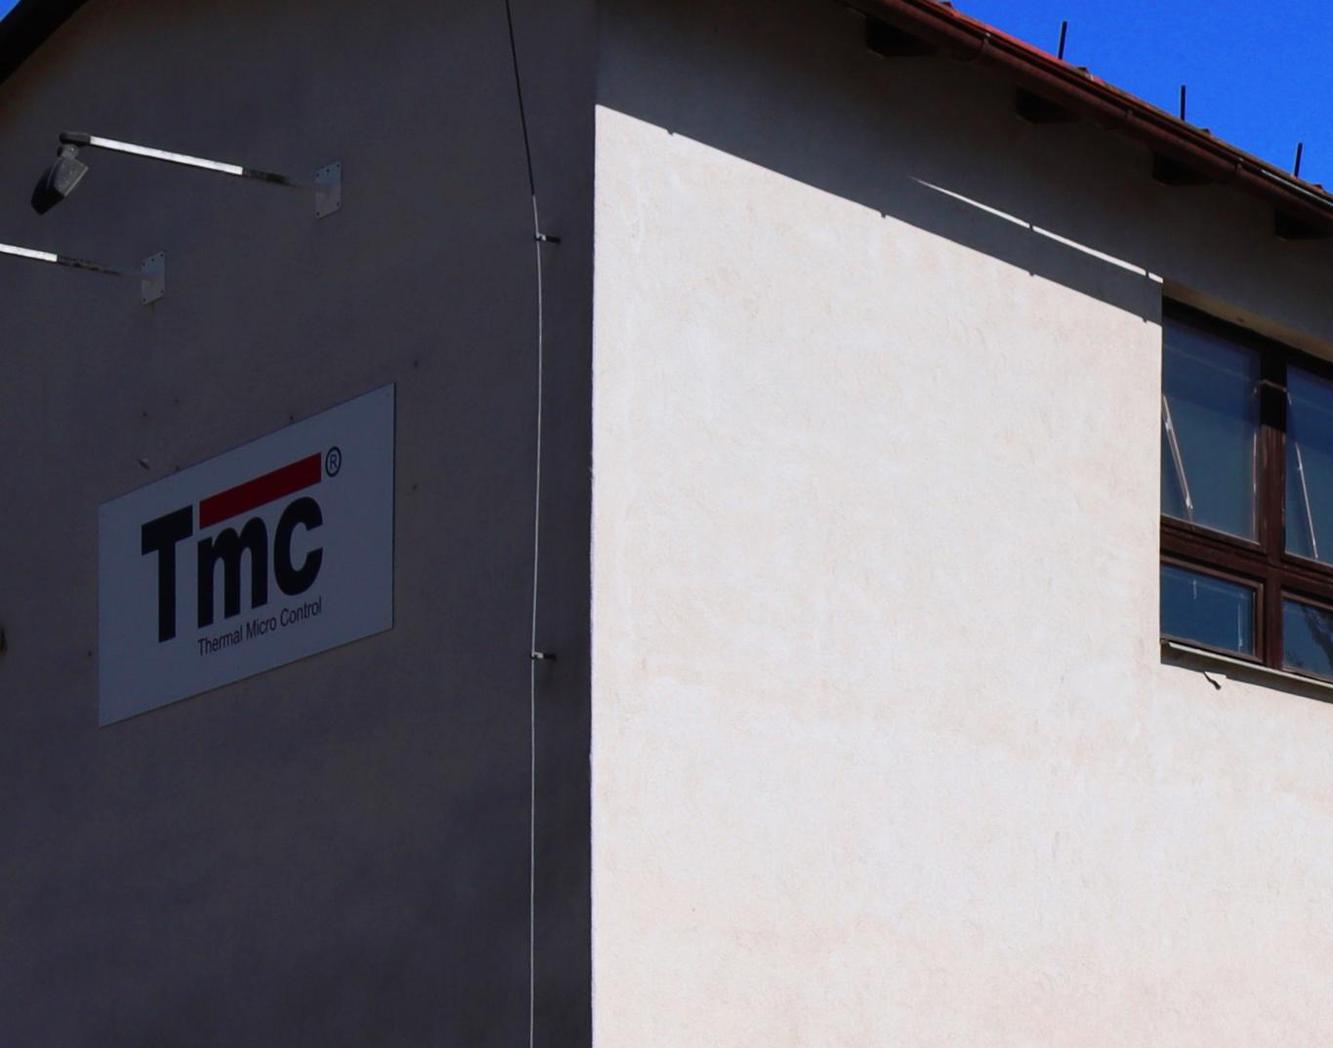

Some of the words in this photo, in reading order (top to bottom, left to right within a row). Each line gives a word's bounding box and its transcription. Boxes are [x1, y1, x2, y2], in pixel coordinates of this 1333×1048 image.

[198, 624, 243, 656] Thermal
[246, 616, 277, 640] Micro
[280, 595, 322, 627] Control
